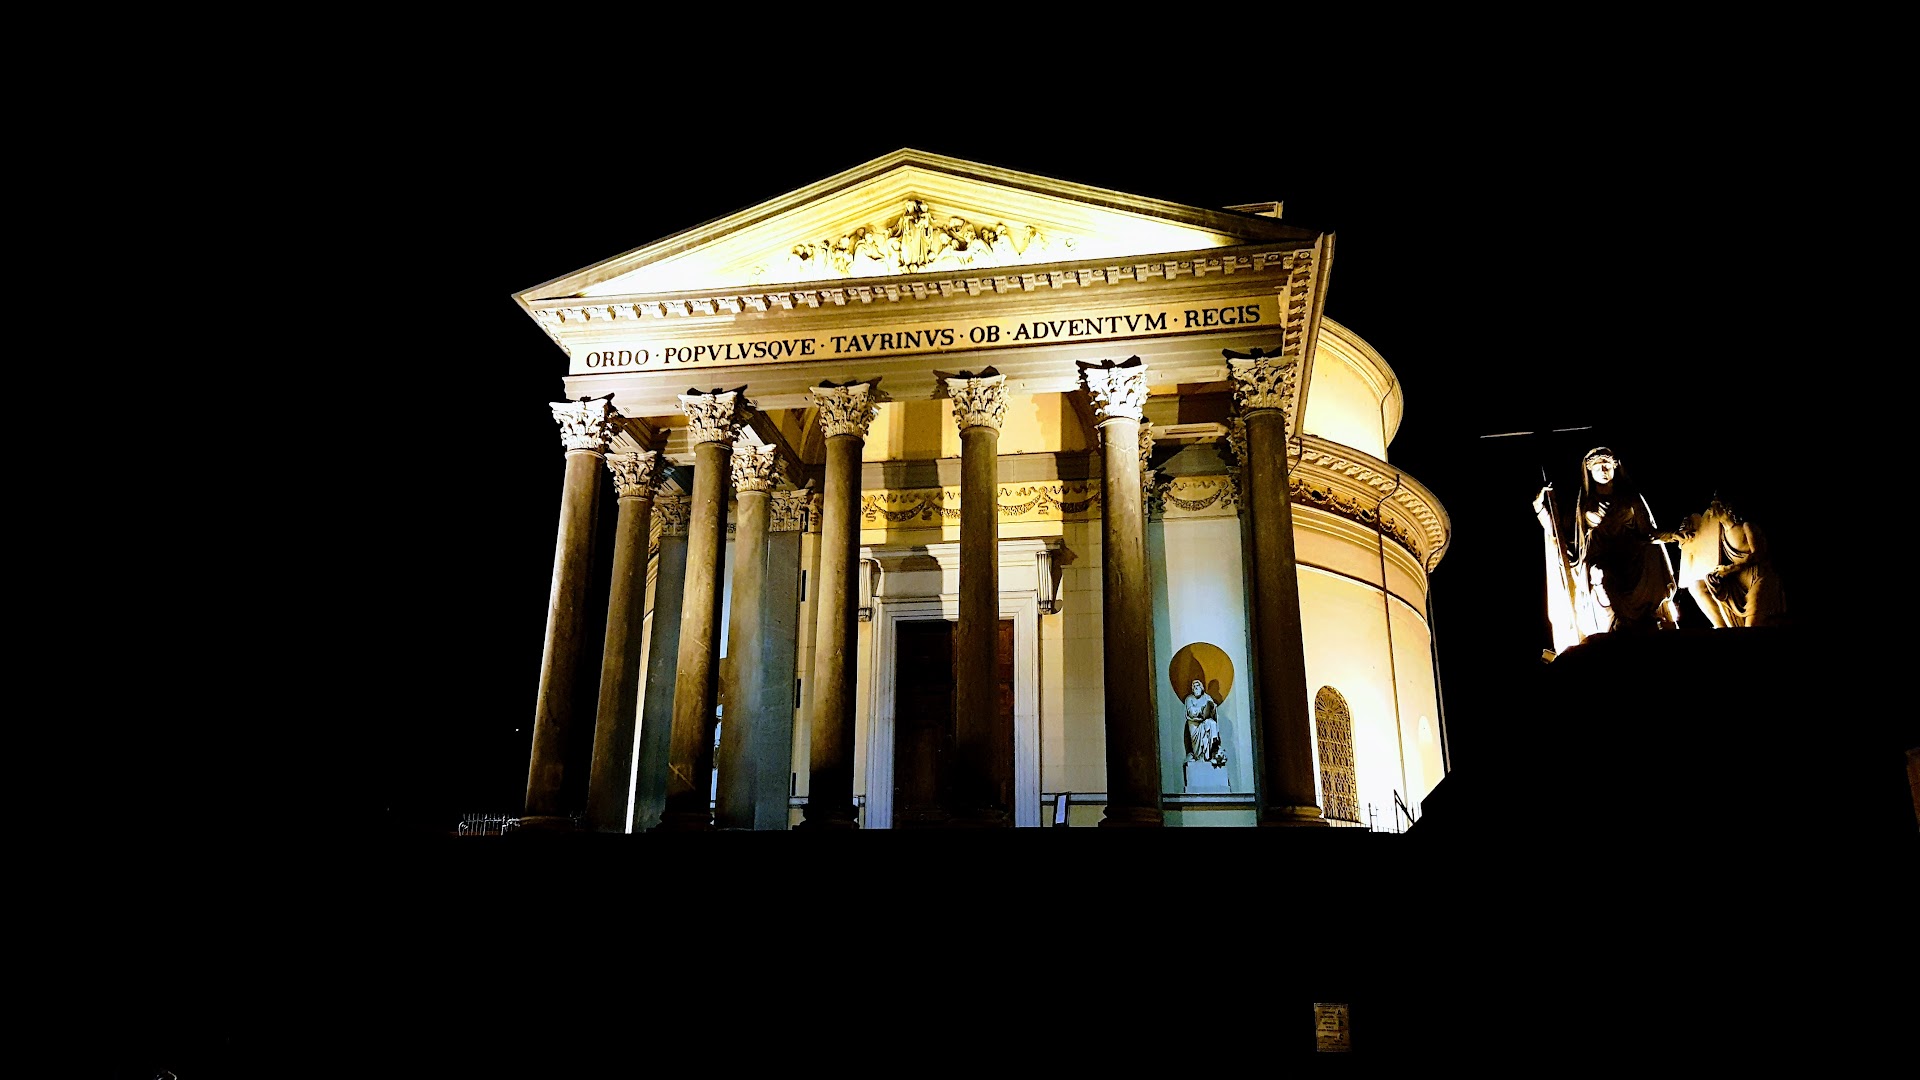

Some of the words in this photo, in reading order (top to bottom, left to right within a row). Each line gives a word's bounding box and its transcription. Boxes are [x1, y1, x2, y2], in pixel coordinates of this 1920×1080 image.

[586, 349, 649, 368] ORDO
[664, 339, 815, 363] POPVLVSQVE
[831, 329, 954, 353] TAVRINVS
[969, 326, 1000, 343] OB
[1013, 312, 1167, 340] ADVENTVM
[1184, 304, 1260, 328] REGIS
